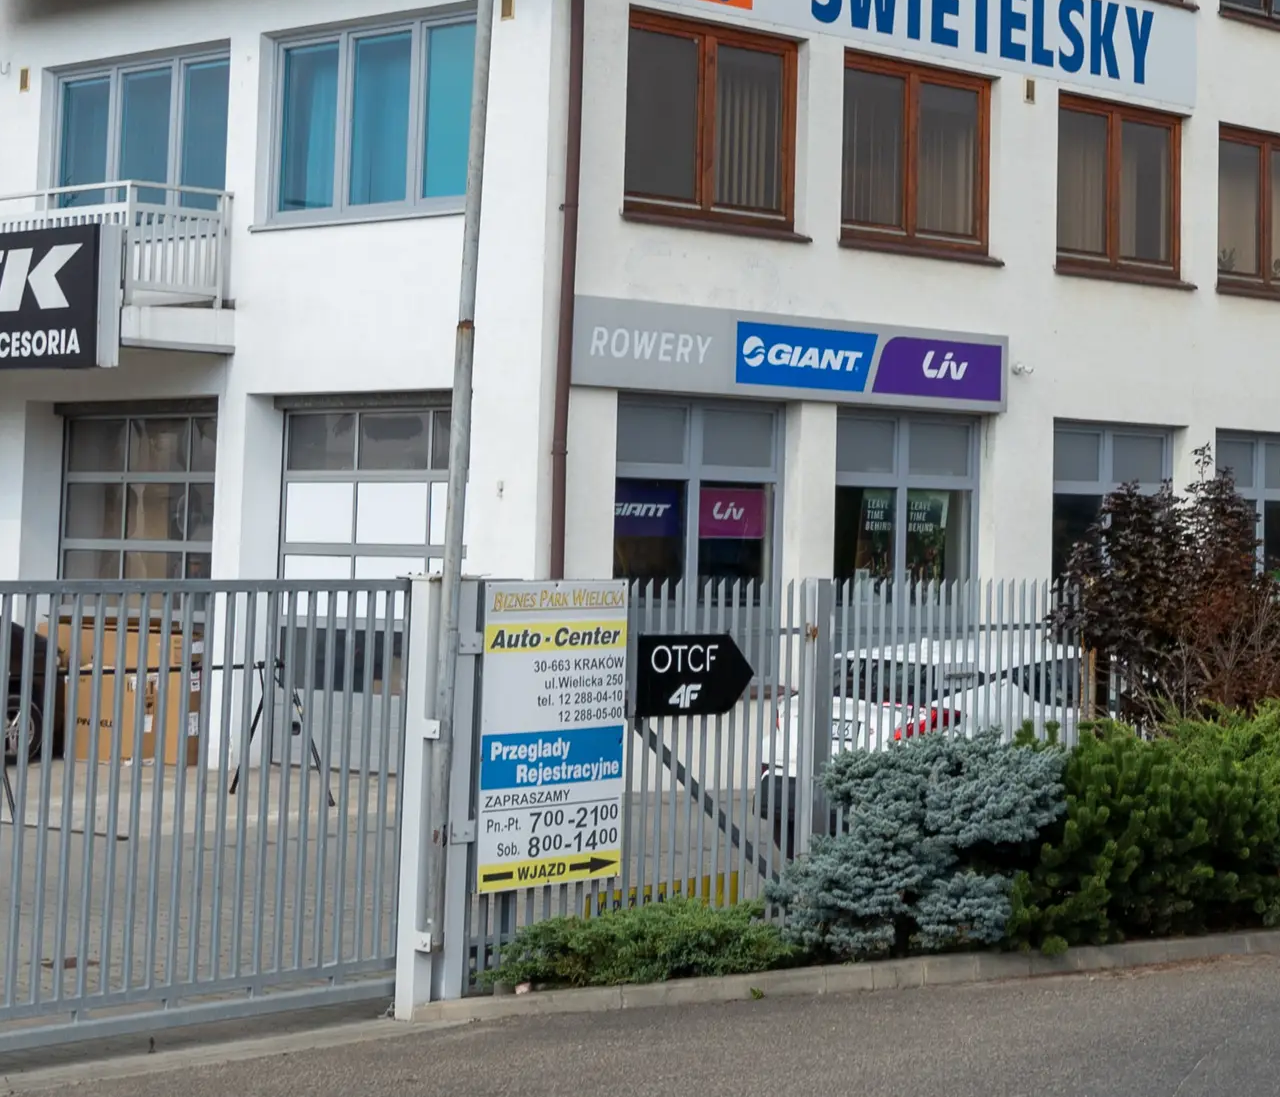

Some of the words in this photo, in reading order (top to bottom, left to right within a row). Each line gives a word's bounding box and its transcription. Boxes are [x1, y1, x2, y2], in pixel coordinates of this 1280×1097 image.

[590, 326, 713, 364] ROWERY
[767, 343, 864, 372] GIANT
[922, 351, 968, 380] Liv
[713, 502, 745, 520] Liv
[867, 510, 884, 520] TIME
[910, 512, 927, 521] TIME
[540, 589, 569, 607] PARK
[534, 659, 571, 673] 30-663
[574, 655, 624, 671] KRAKÓW
[651, 644, 719, 673] OTCF
[606, 673, 623, 687] 250
[537, 694, 555, 707] tel.
[559, 693, 571, 705] 12
[574, 690, 623, 704] 288-04-10
[668, 683, 702, 709] 4F
[559, 711, 571, 722] 12
[574, 706, 623, 721] 288-05-00
[516, 757, 619, 786] Rejestracyjne
[485, 789, 571, 809] ZAPRASZAMY
[497, 842, 520, 857] Sob.
[517, 862, 566, 881] WJAZD
